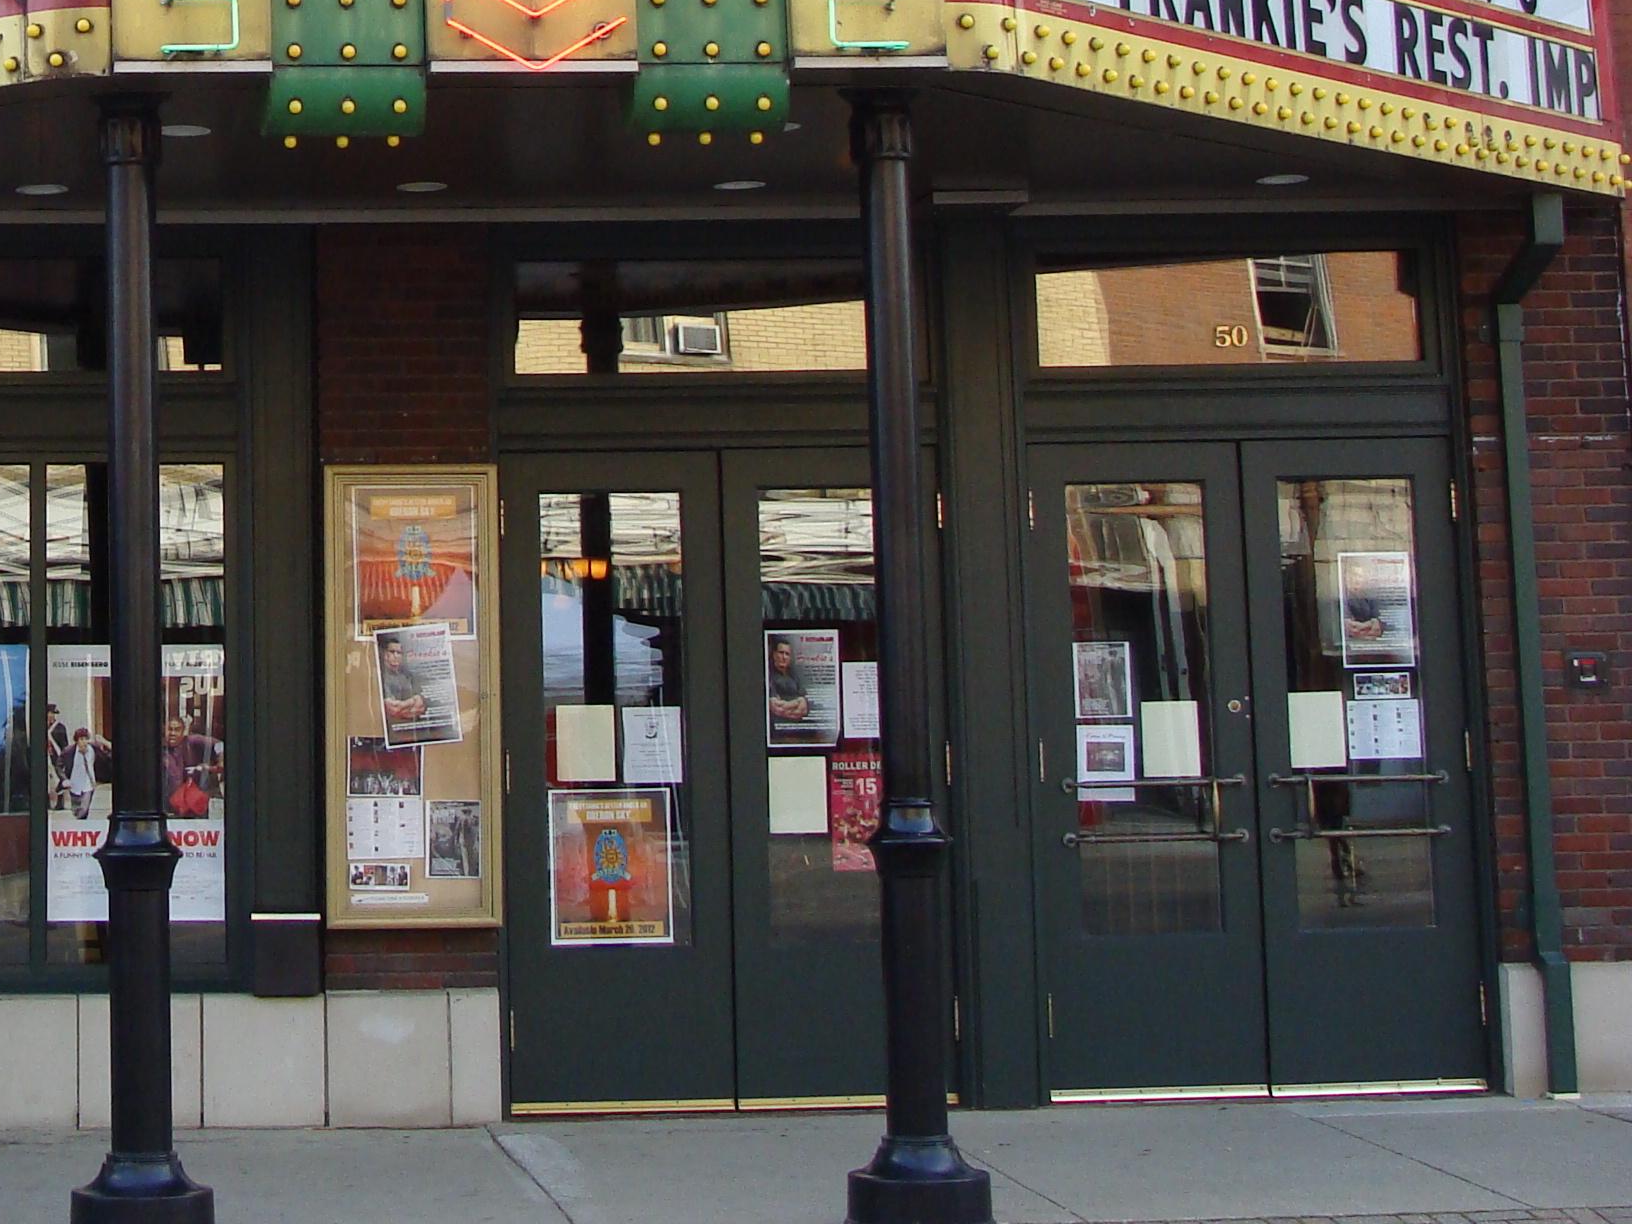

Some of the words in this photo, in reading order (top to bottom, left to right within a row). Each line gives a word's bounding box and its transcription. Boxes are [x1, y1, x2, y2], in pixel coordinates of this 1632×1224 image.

[1394, 5, 1508, 102] REST.
[1532, 41, 1596, 114] IMP
[1215, 325, 1249, 348] 50
[832, 761, 868, 770] ROLLER
[856, 777, 877, 795] 15
[52, 831, 101, 847] WHY
[168, 831, 220, 847] NOW
